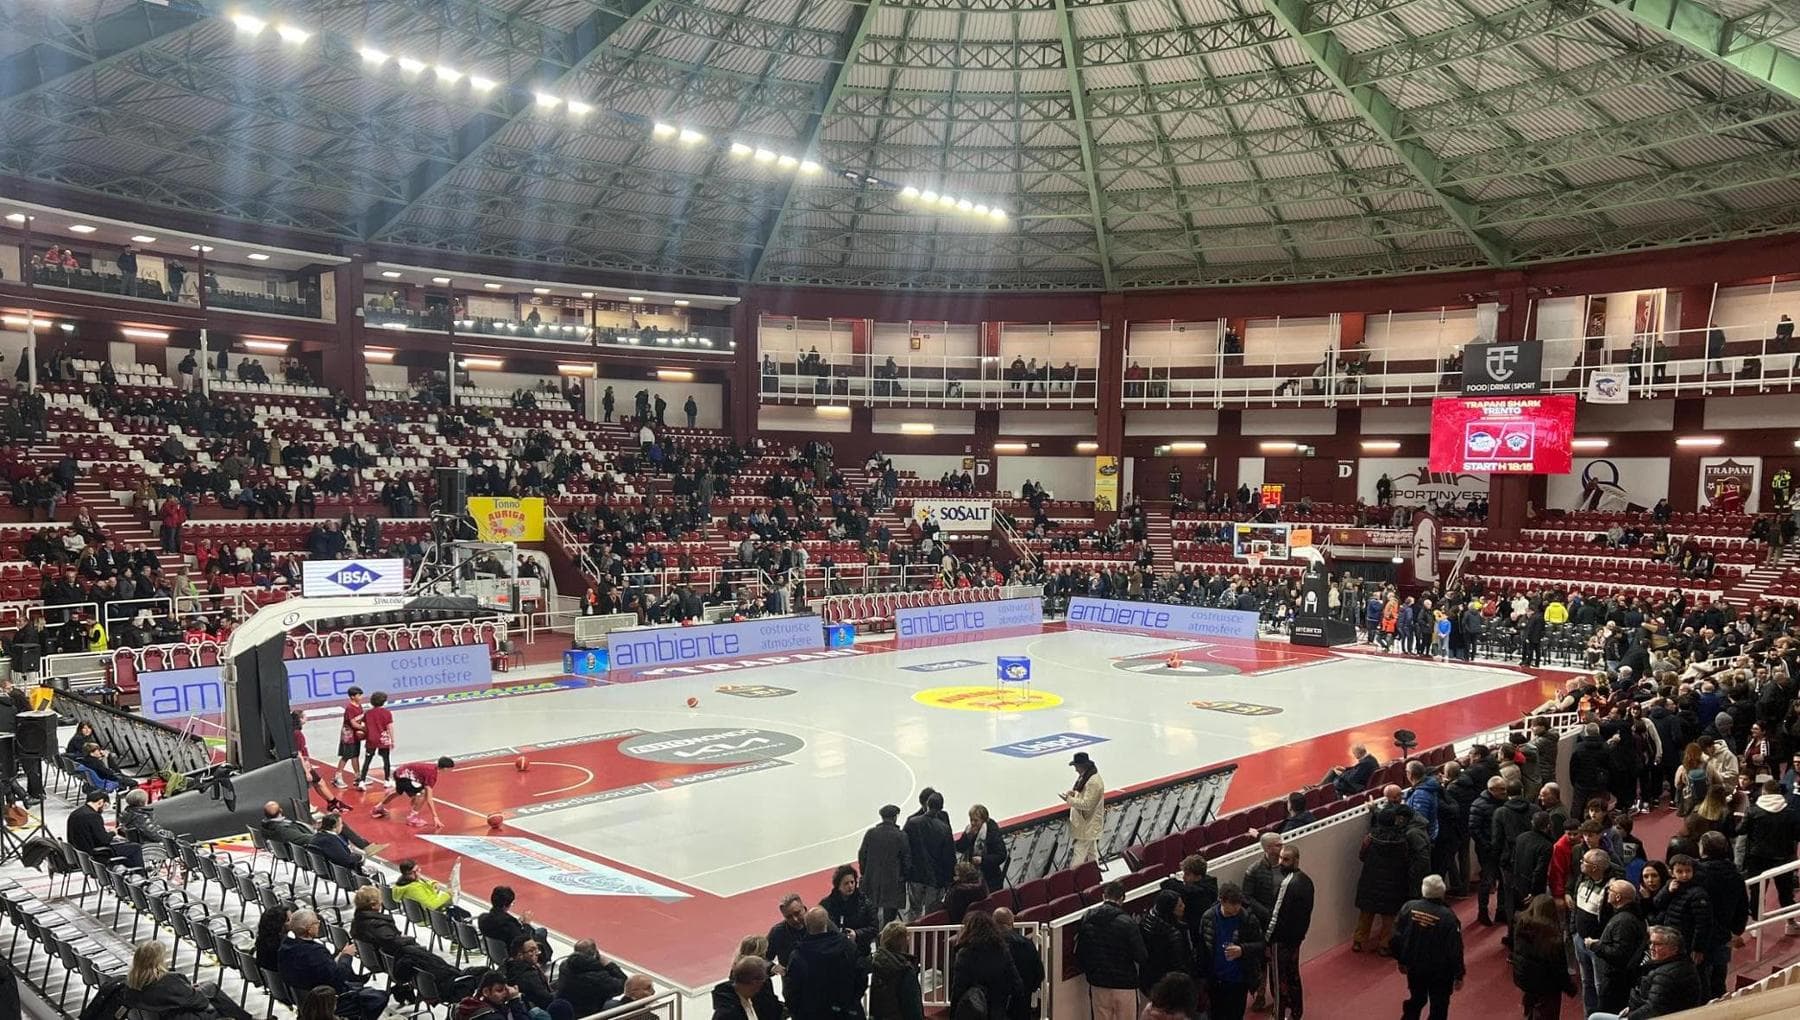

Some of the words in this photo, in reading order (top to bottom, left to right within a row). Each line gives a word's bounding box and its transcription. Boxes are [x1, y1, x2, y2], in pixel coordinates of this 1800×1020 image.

[1465, 400, 1506, 408] TRAPANI
[1507, 399, 1541, 408] SHARK
[1483, 407, 1522, 415] TRENTO
[976, 463, 989, 476] D
[1338, 464, 1353, 478] D
[1463, 462, 1497, 471] START
[1706, 466, 1753, 474] TRAPANI
[1262, 492, 1281, 505] 24
[337, 570, 373, 584] IBSA
[900, 609, 985, 636] ambiente
[1070, 602, 1170, 629] ambiente
[759, 622, 811, 637] costruisce
[1188, 621, 1242, 636] atmosfere
[615, 631, 740, 666] ambiente
[761, 635, 813, 651] atmosfere
[391, 652, 470, 671] costruisce
[391, 668, 473, 689] atmosfere
[152, 666, 356, 715] amnte
[516, 785, 651, 815] fotodiscount
